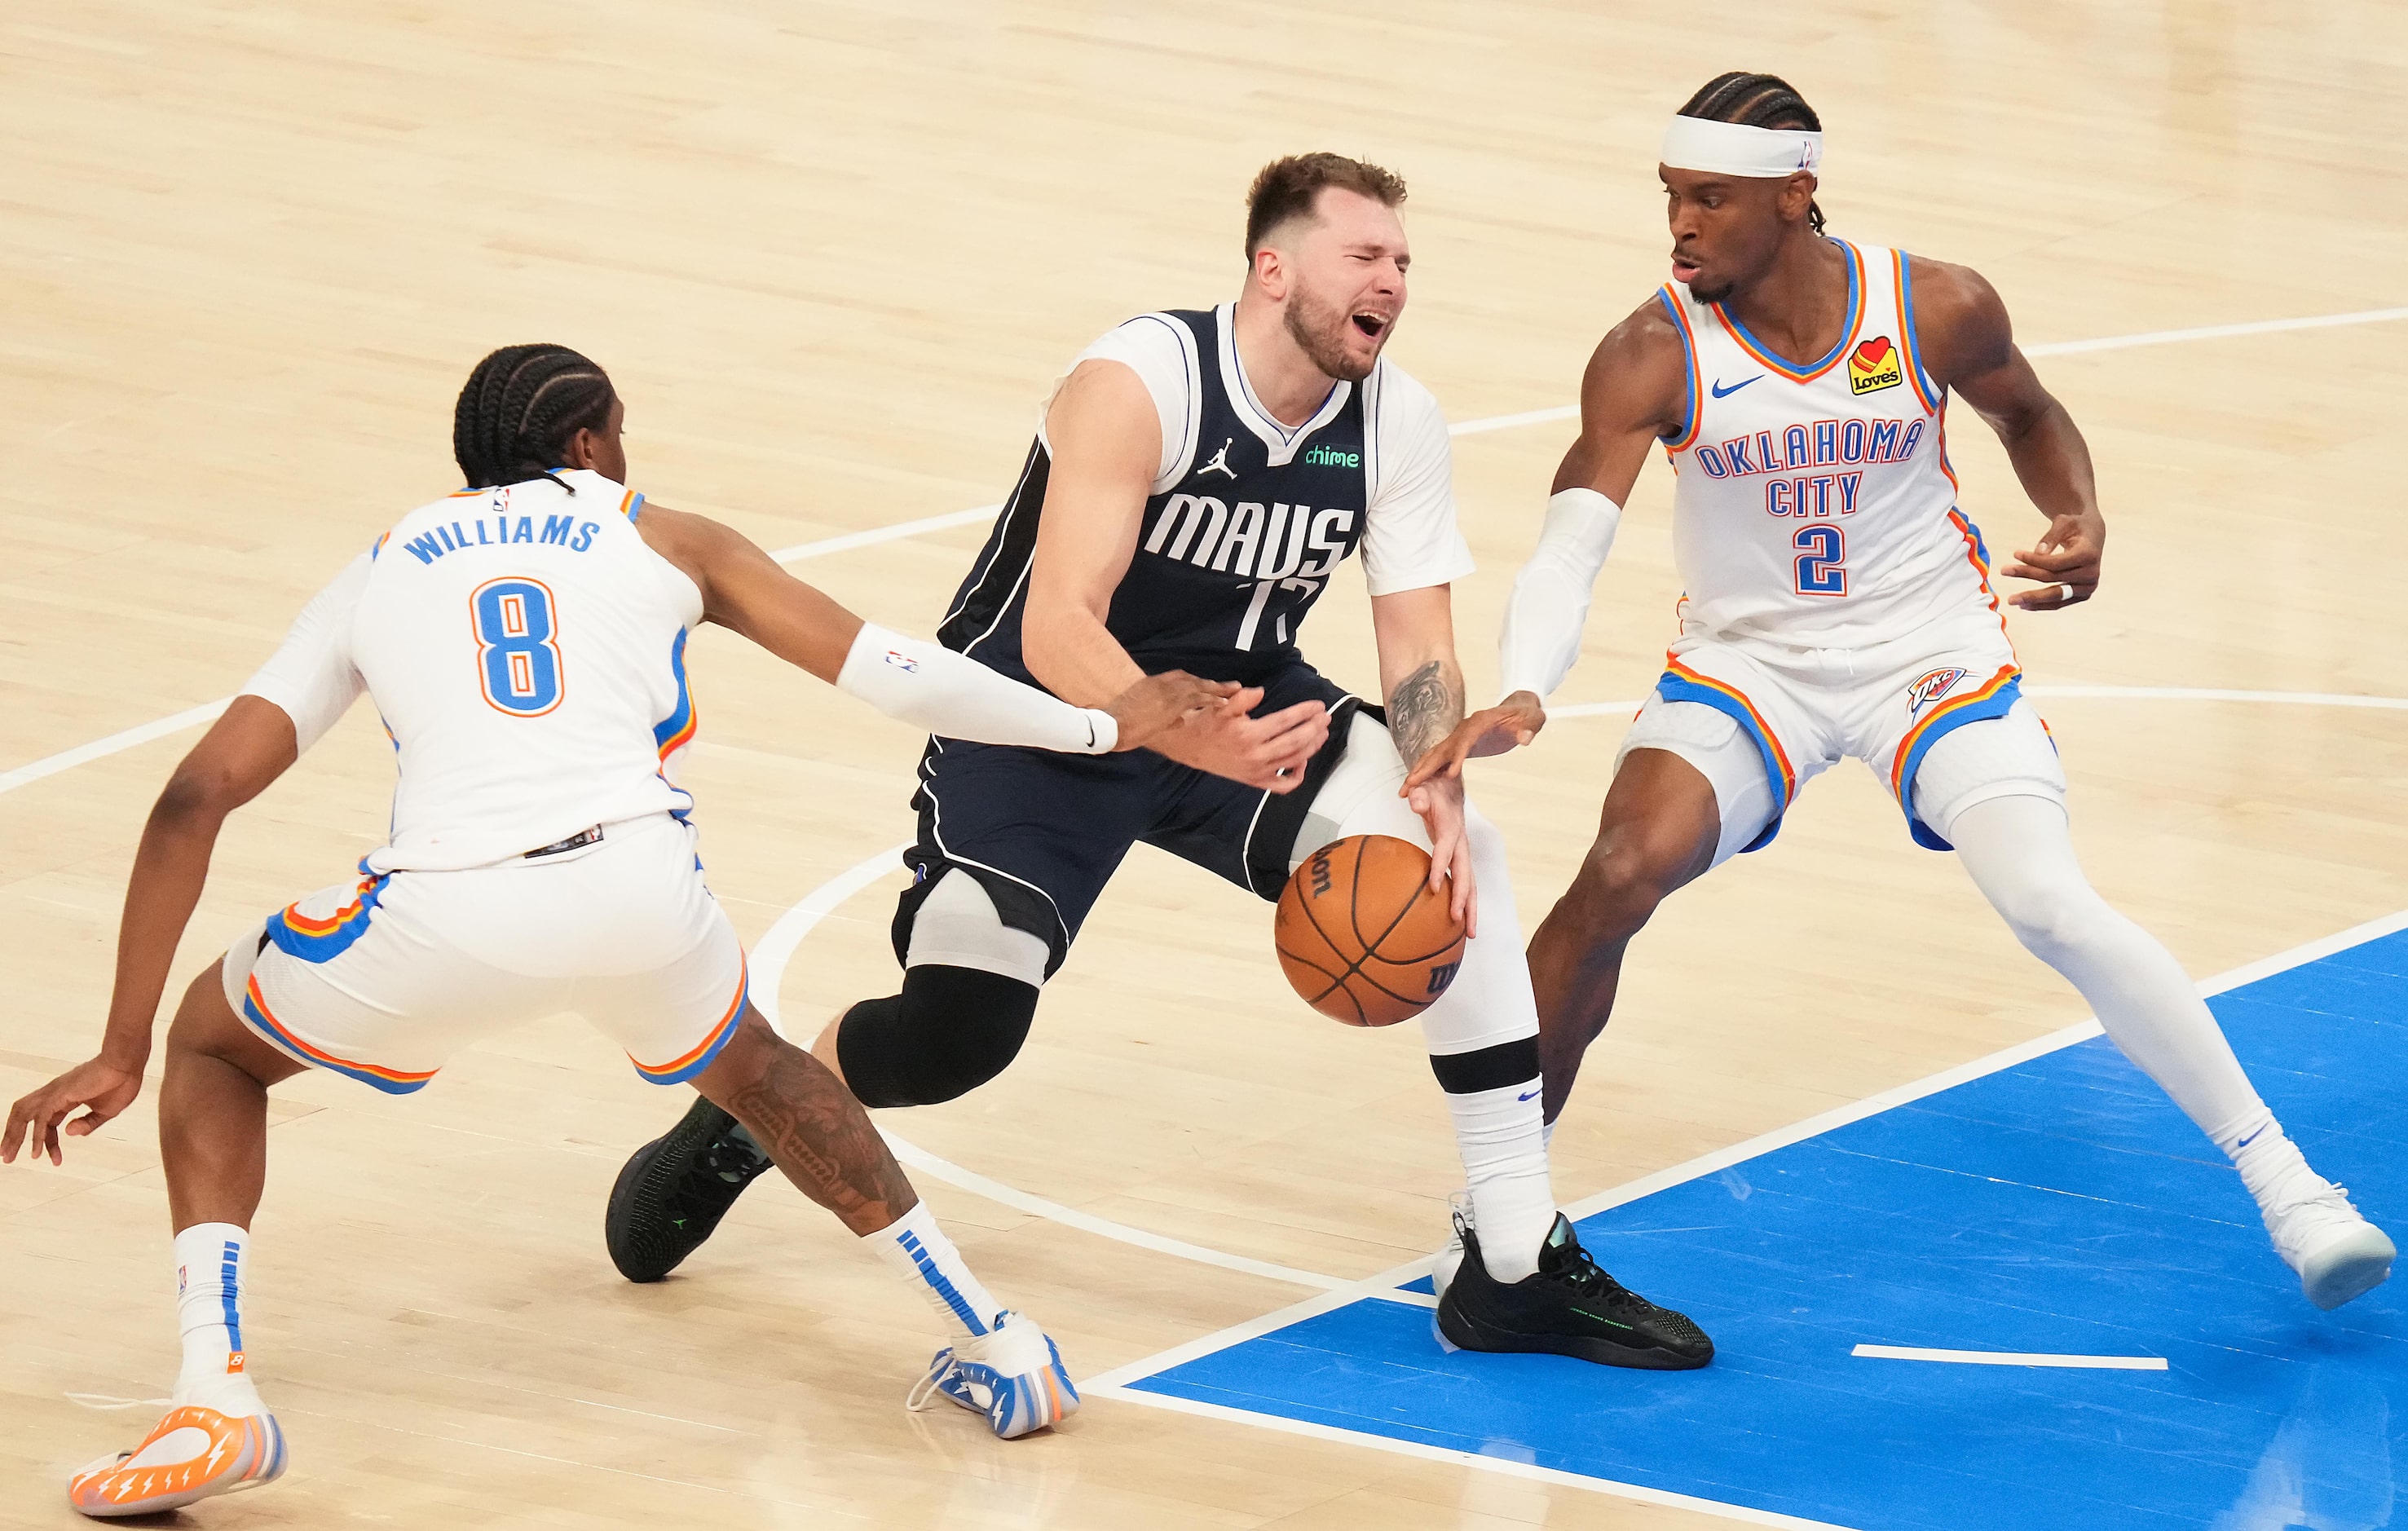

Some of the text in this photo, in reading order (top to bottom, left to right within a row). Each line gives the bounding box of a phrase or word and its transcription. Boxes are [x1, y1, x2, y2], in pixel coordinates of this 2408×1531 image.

[1306, 444, 1359, 468] chime
[1696, 418, 1926, 479] OKLAHOMA
[1766, 470, 1863, 518] CITY
[403, 514, 601, 565] WILLIAMS
[1144, 493, 1354, 580] MAVS
[1793, 523, 1847, 597] 2
[469, 576, 565, 718] 8
[230, 1355, 244, 1366] 8
